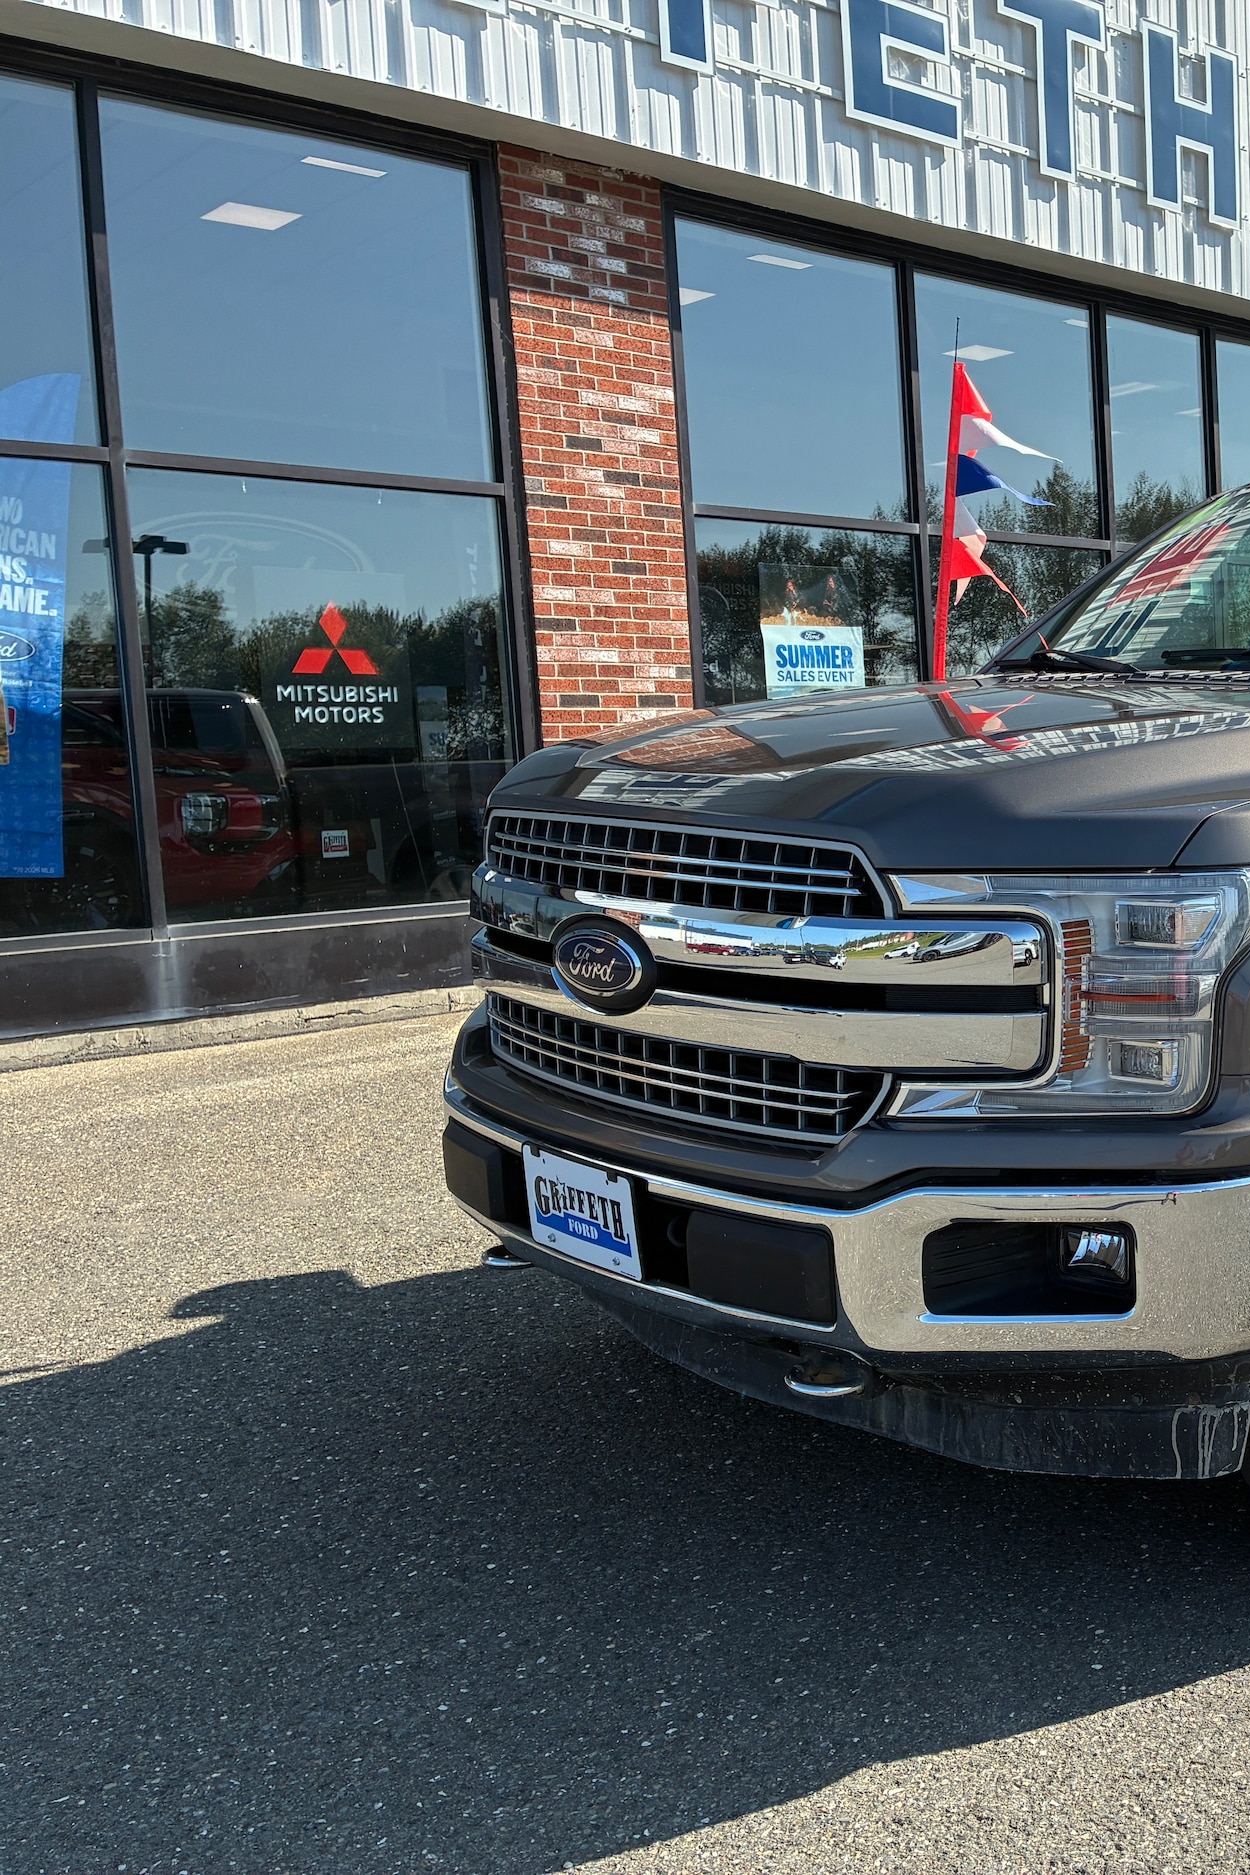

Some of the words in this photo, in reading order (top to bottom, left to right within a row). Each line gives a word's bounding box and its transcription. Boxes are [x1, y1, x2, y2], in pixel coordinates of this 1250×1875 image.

[776, 644, 854, 669] SUMMER
[777, 670, 815, 682] SALES
[818, 671, 855, 682] EVENT
[276, 684, 399, 703] MITSUBISHI
[294, 706, 385, 724] MOTORS
[569, 942, 616, 982] Ford
[534, 1175, 626, 1242] GRIFFETH
[567, 1217, 599, 1241] FORD
